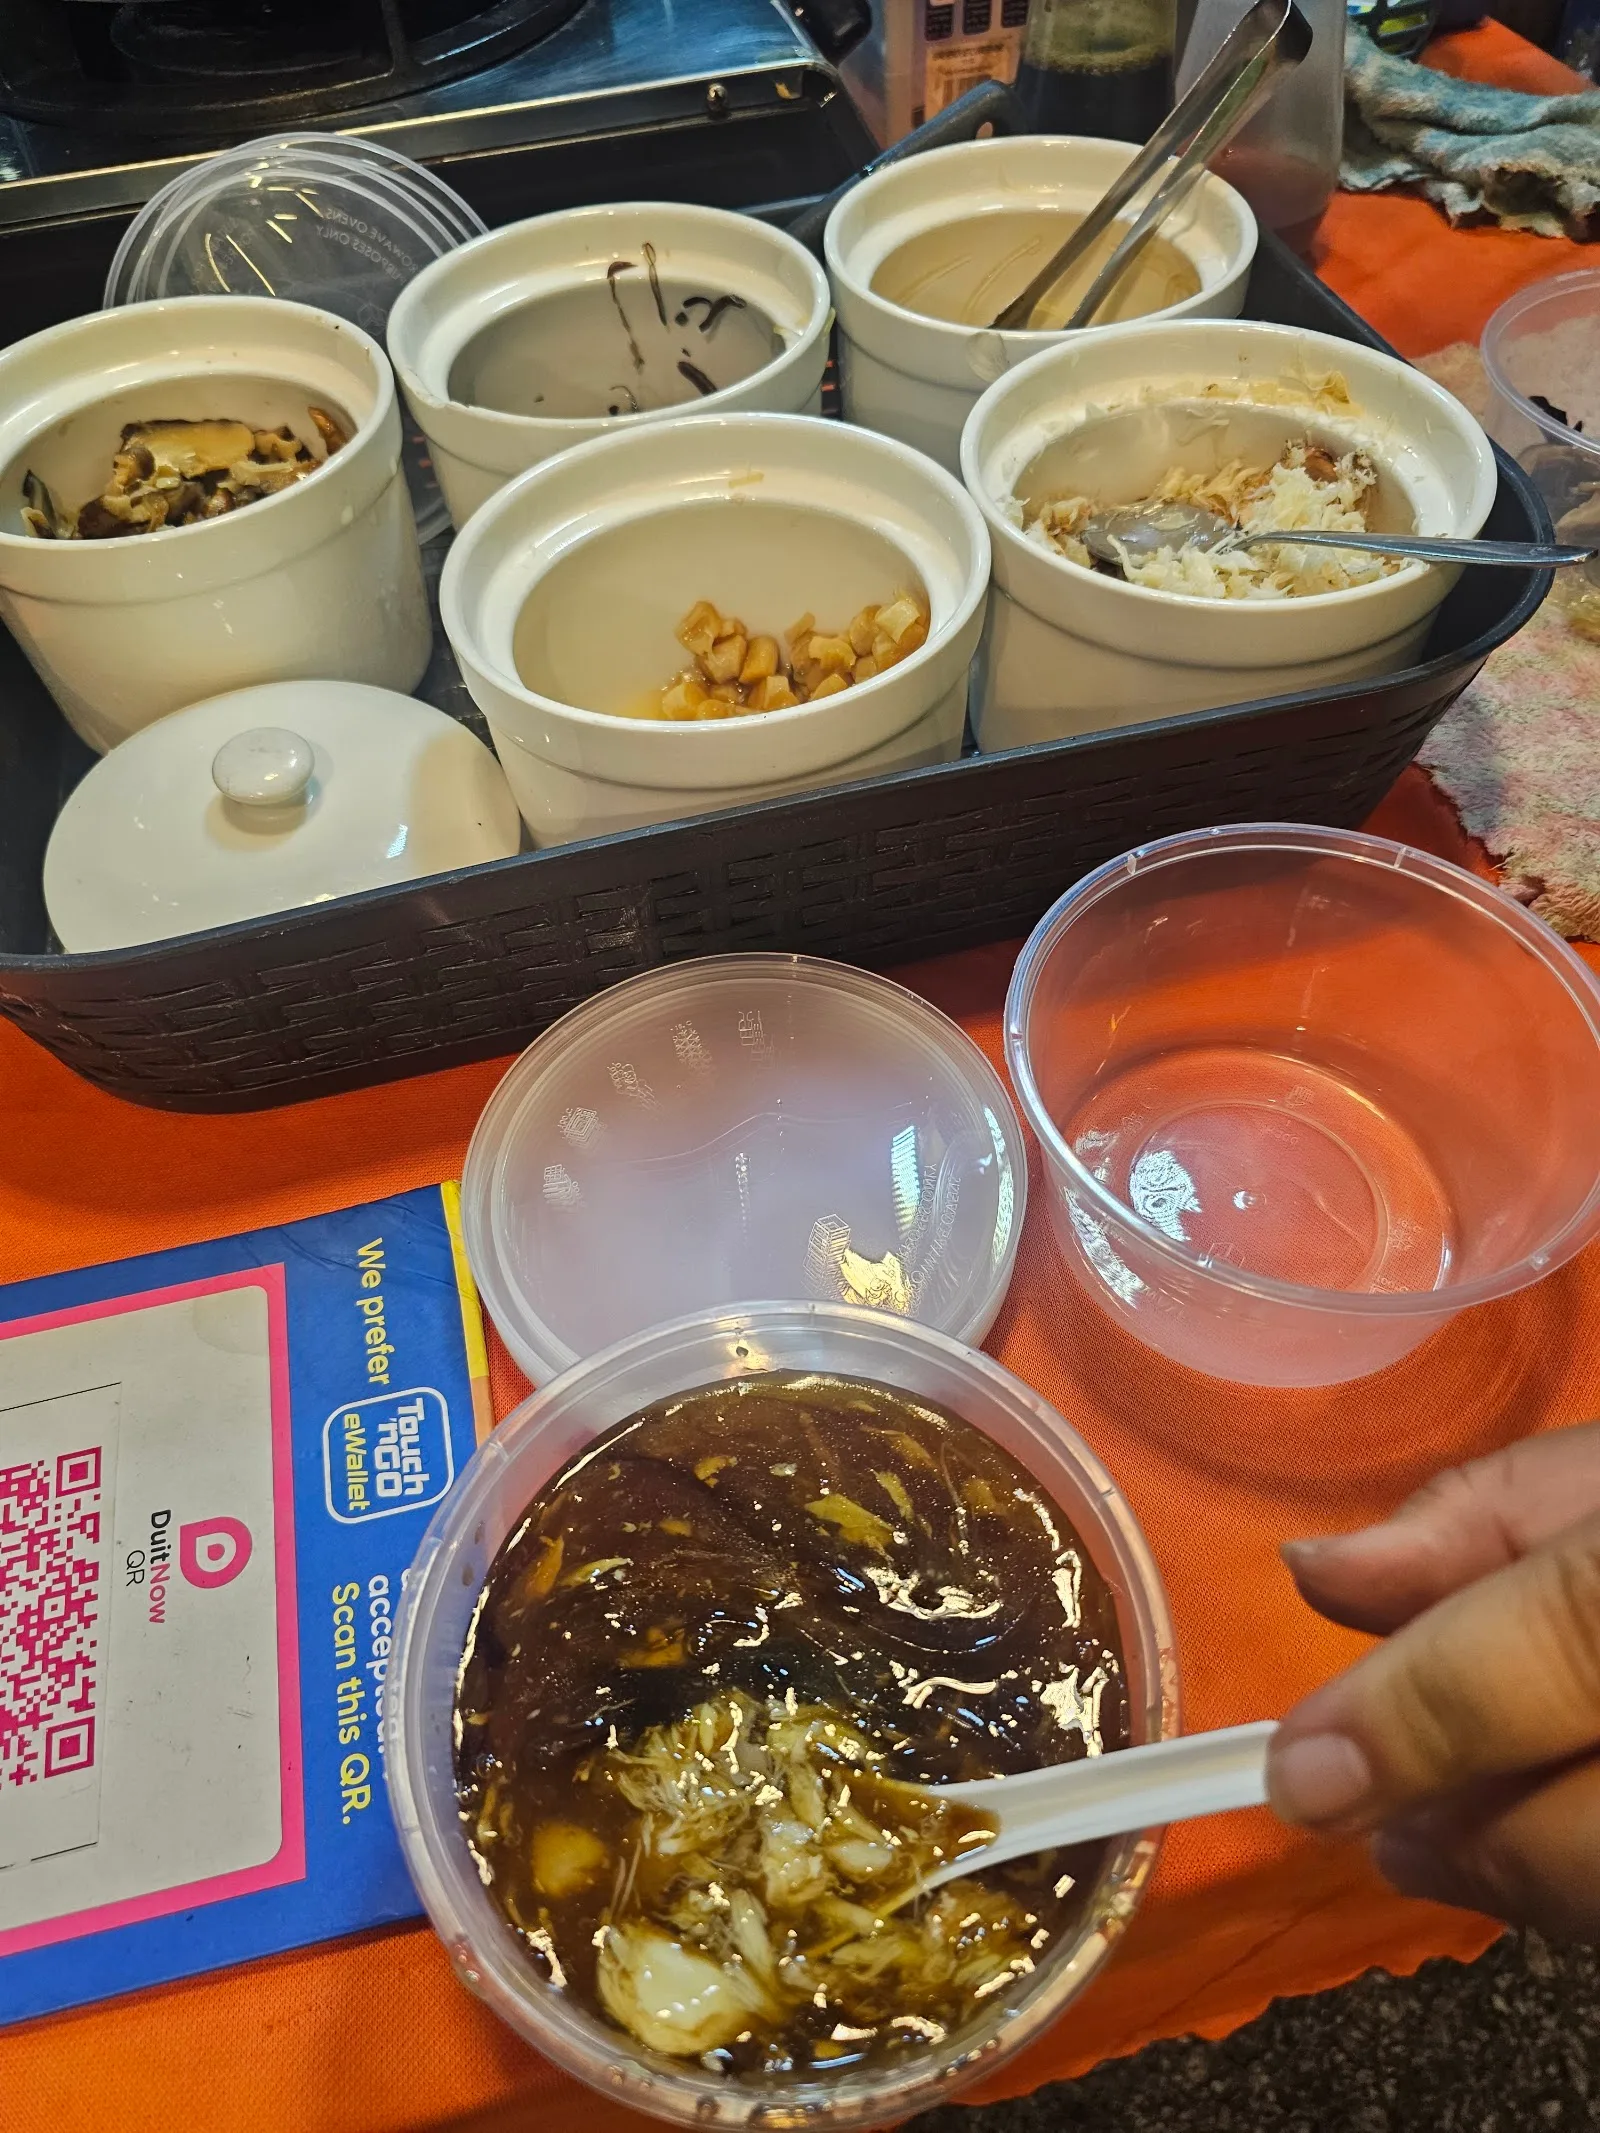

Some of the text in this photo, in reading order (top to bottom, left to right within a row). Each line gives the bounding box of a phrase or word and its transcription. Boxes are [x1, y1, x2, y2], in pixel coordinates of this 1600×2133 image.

[356, 1237, 395, 1385] We prefer
[343, 1413, 371, 1510] eWallet
[397, 1398, 430, 1496] Touch
[126, 1550, 146, 1587] QR
[149, 1509, 171, 1623] DuitNow
[332, 1582, 371, 1825] Scan this QR.
